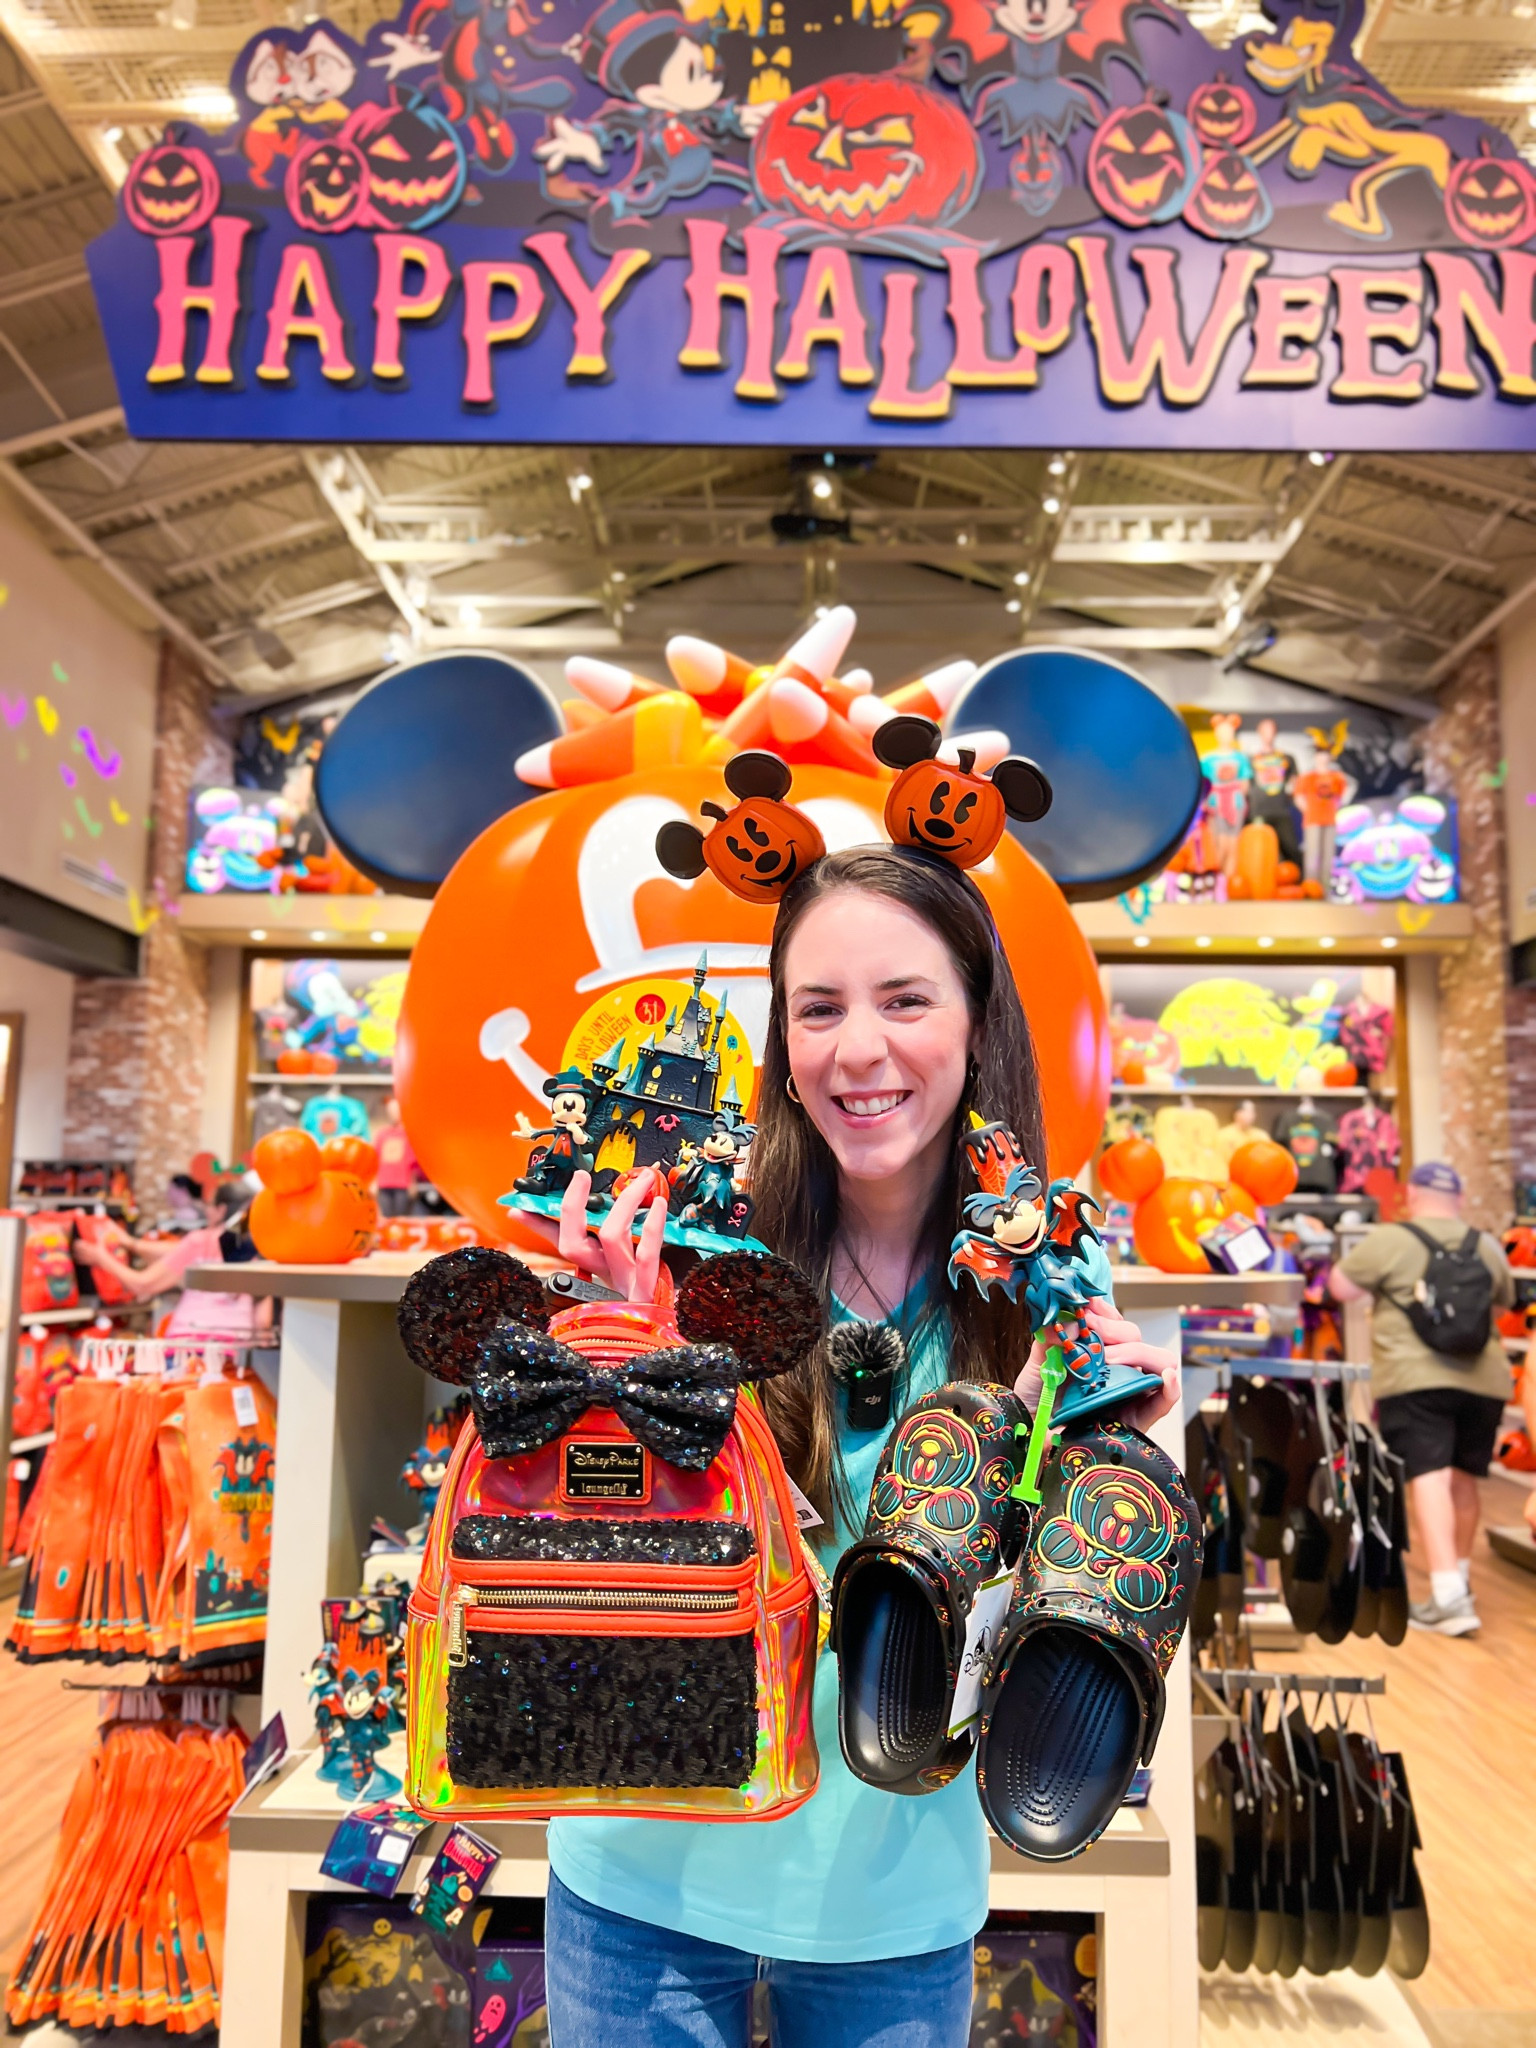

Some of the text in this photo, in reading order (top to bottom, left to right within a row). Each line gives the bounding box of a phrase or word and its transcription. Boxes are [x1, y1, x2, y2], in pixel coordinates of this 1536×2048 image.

[146, 217, 1536, 417] HAPPY HALLOWEEN
[575, 1011, 615, 1060] DAYS UNTIL
[642, 1000, 658, 1025] 31
